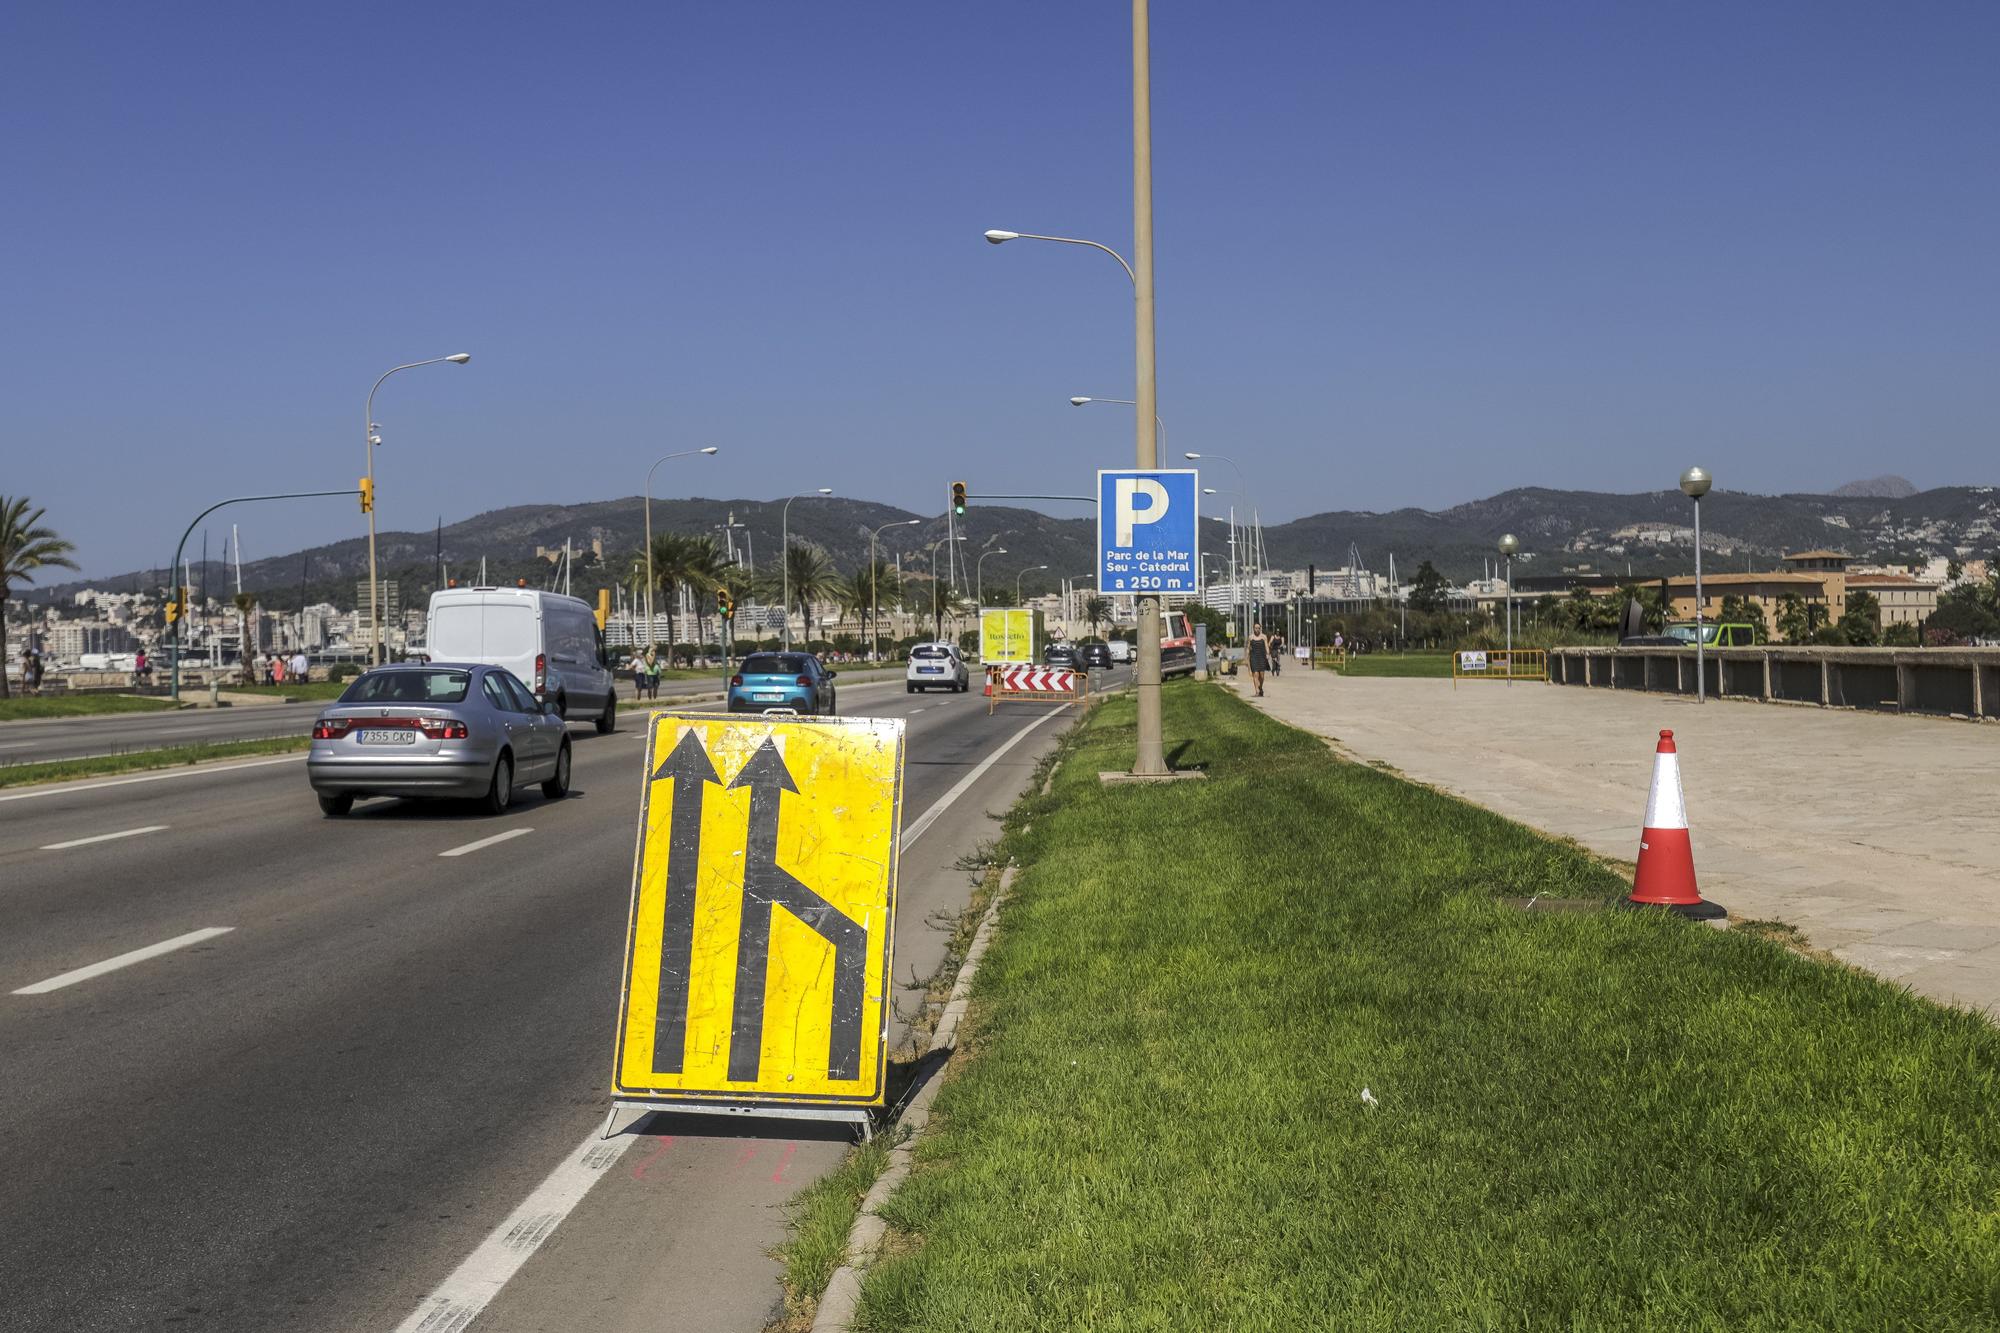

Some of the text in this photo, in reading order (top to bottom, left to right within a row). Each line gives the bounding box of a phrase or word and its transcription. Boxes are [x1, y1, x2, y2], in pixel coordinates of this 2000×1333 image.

[1116, 479, 1169, 547] P
[1106, 551, 1189, 560] Parc de la Mar
[1106, 562, 1128, 572] Seu
[1139, 562, 1190, 572] Catedral
[1115, 579, 1124, 588] a
[1130, 577, 1161, 588] 250
[363, 731, 413, 742] 7355 CKP
